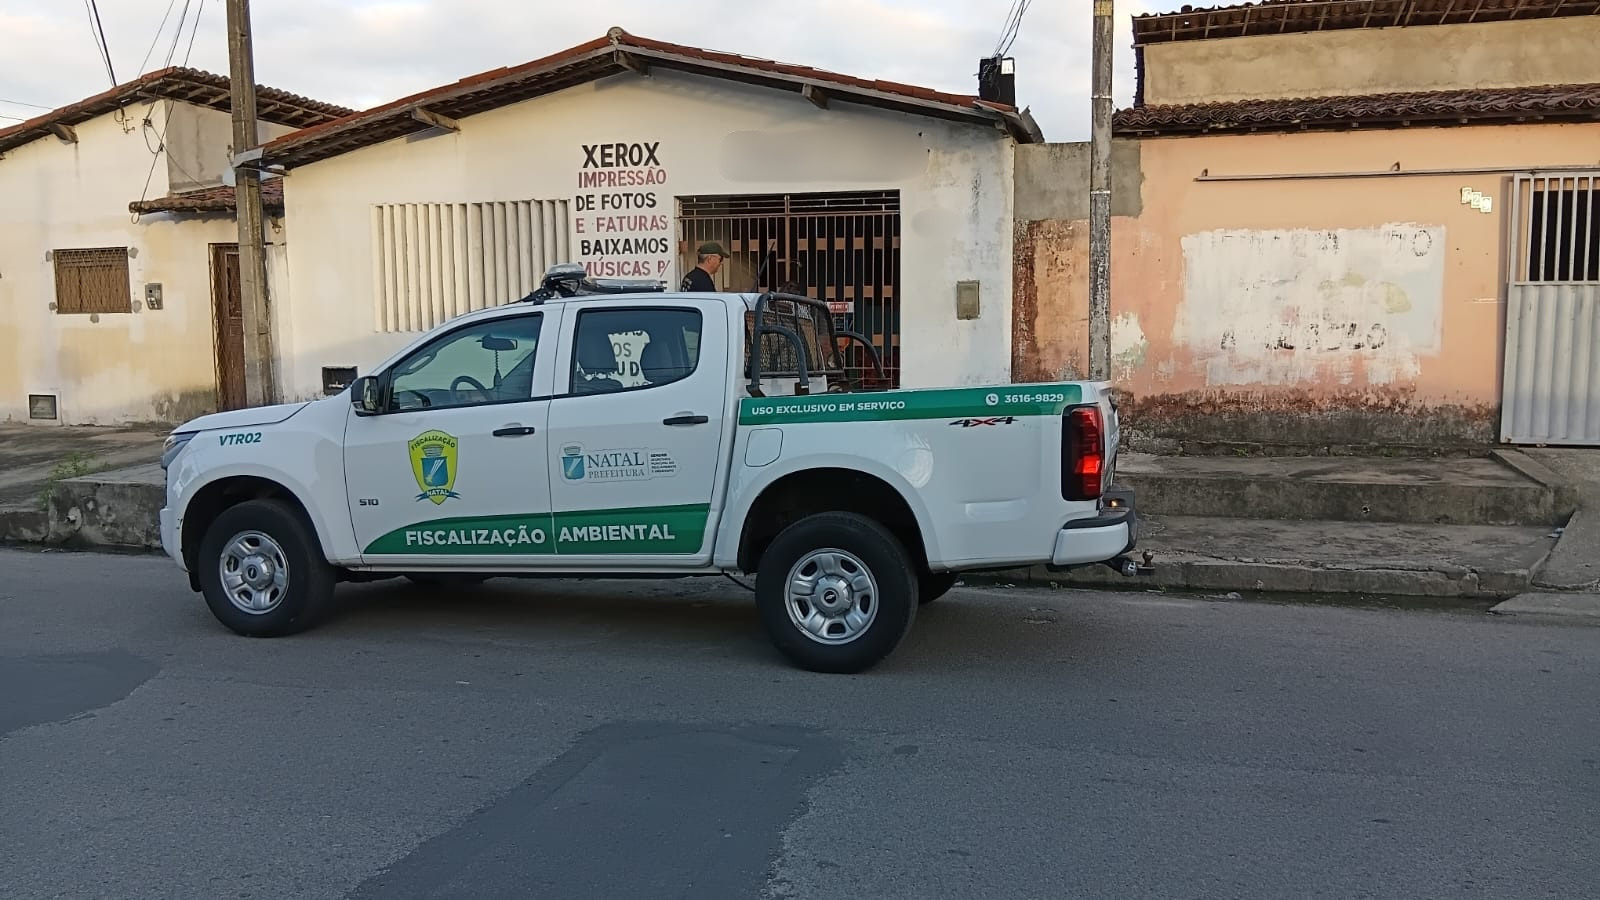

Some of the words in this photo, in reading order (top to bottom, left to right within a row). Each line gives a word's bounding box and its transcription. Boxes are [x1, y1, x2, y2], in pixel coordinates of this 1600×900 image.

[581, 142, 660, 168] XEROX
[578, 167, 667, 188] IMPRESSÃO
[575, 194, 595, 211] DE
[601, 192, 657, 210] FOTOS
[575, 218, 585, 233] E
[596, 215, 668, 233] FATURAS
[581, 237, 669, 255] BAIXAMOS
[577, 256, 651, 277] MÚSICAS
[657, 260, 670, 278] P/
[1004, 393, 1064, 404] 3616-9829
[752, 406, 774, 415] USO
[776, 404, 836, 414] EXCLUSIVO
[839, 402, 855, 412] EM
[219, 432, 262, 446] VTR02
[411, 435, 455, 451] FISCALIZAÇÃO
[587, 452, 645, 469] NATAL
[588, 469, 645, 479] PREFEITURA
[426, 488, 450, 497] NATAL
[359, 498, 379, 506] S10
[405, 525, 546, 547] FISCALIZAÇÃO
[558, 524, 675, 542] AMBIENTAL
